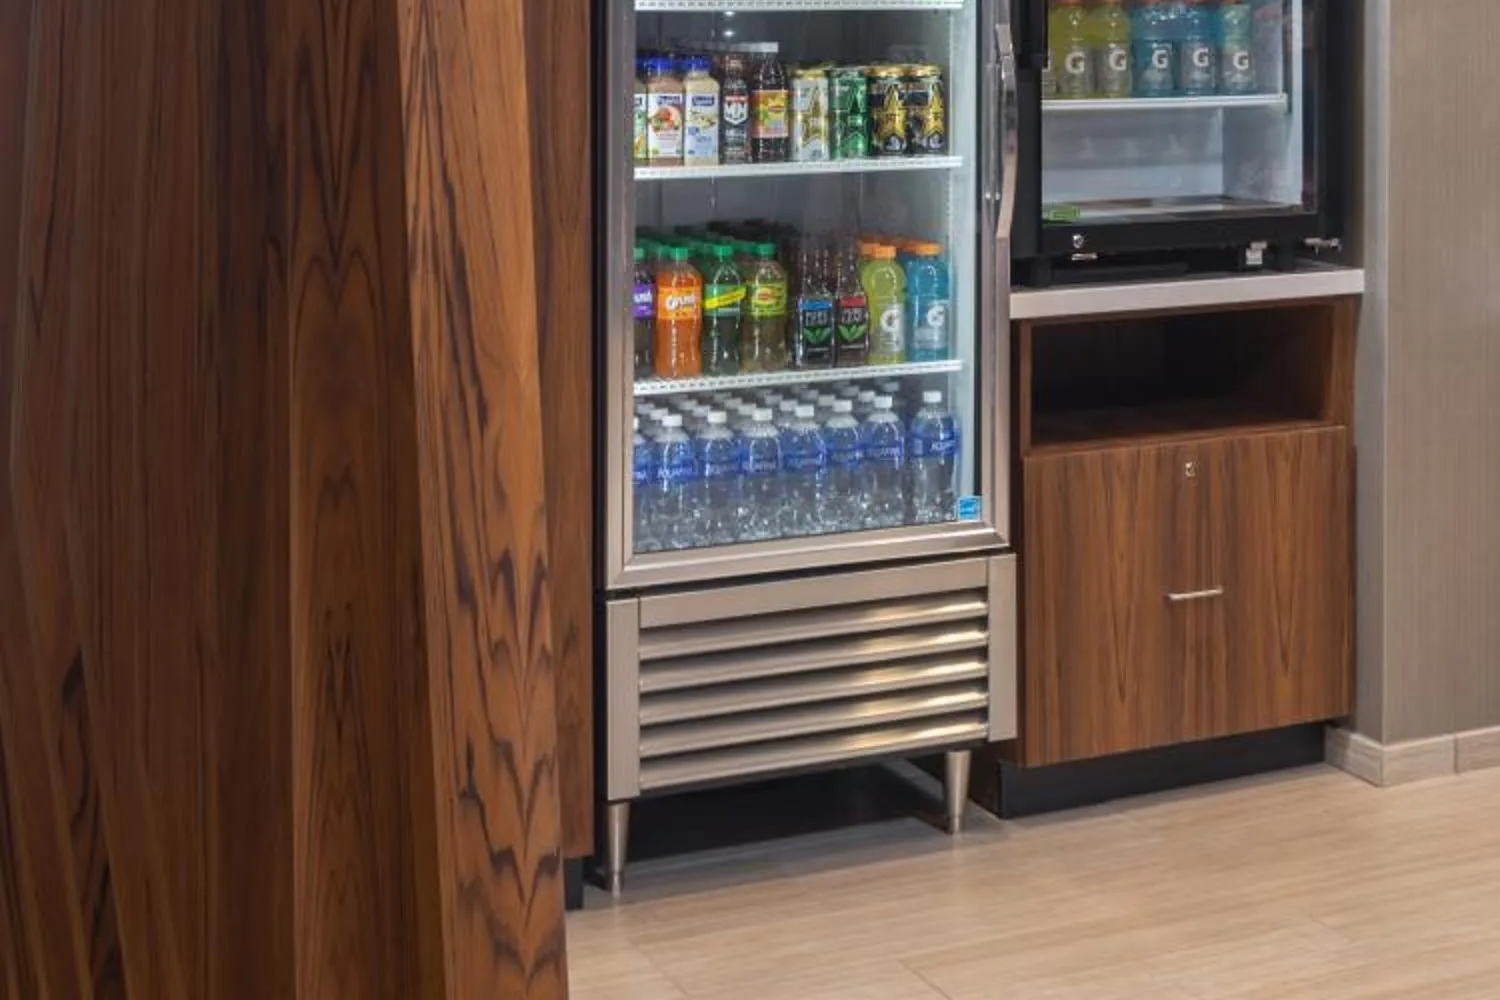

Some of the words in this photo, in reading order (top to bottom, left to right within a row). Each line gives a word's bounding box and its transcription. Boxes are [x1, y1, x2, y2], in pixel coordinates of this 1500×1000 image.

[1065, 51, 1086, 74] G
[1109, 49, 1127, 72] G
[1152, 49, 1169, 70] G
[1192, 47, 1209, 68] G
[1232, 51, 1250, 71] G
